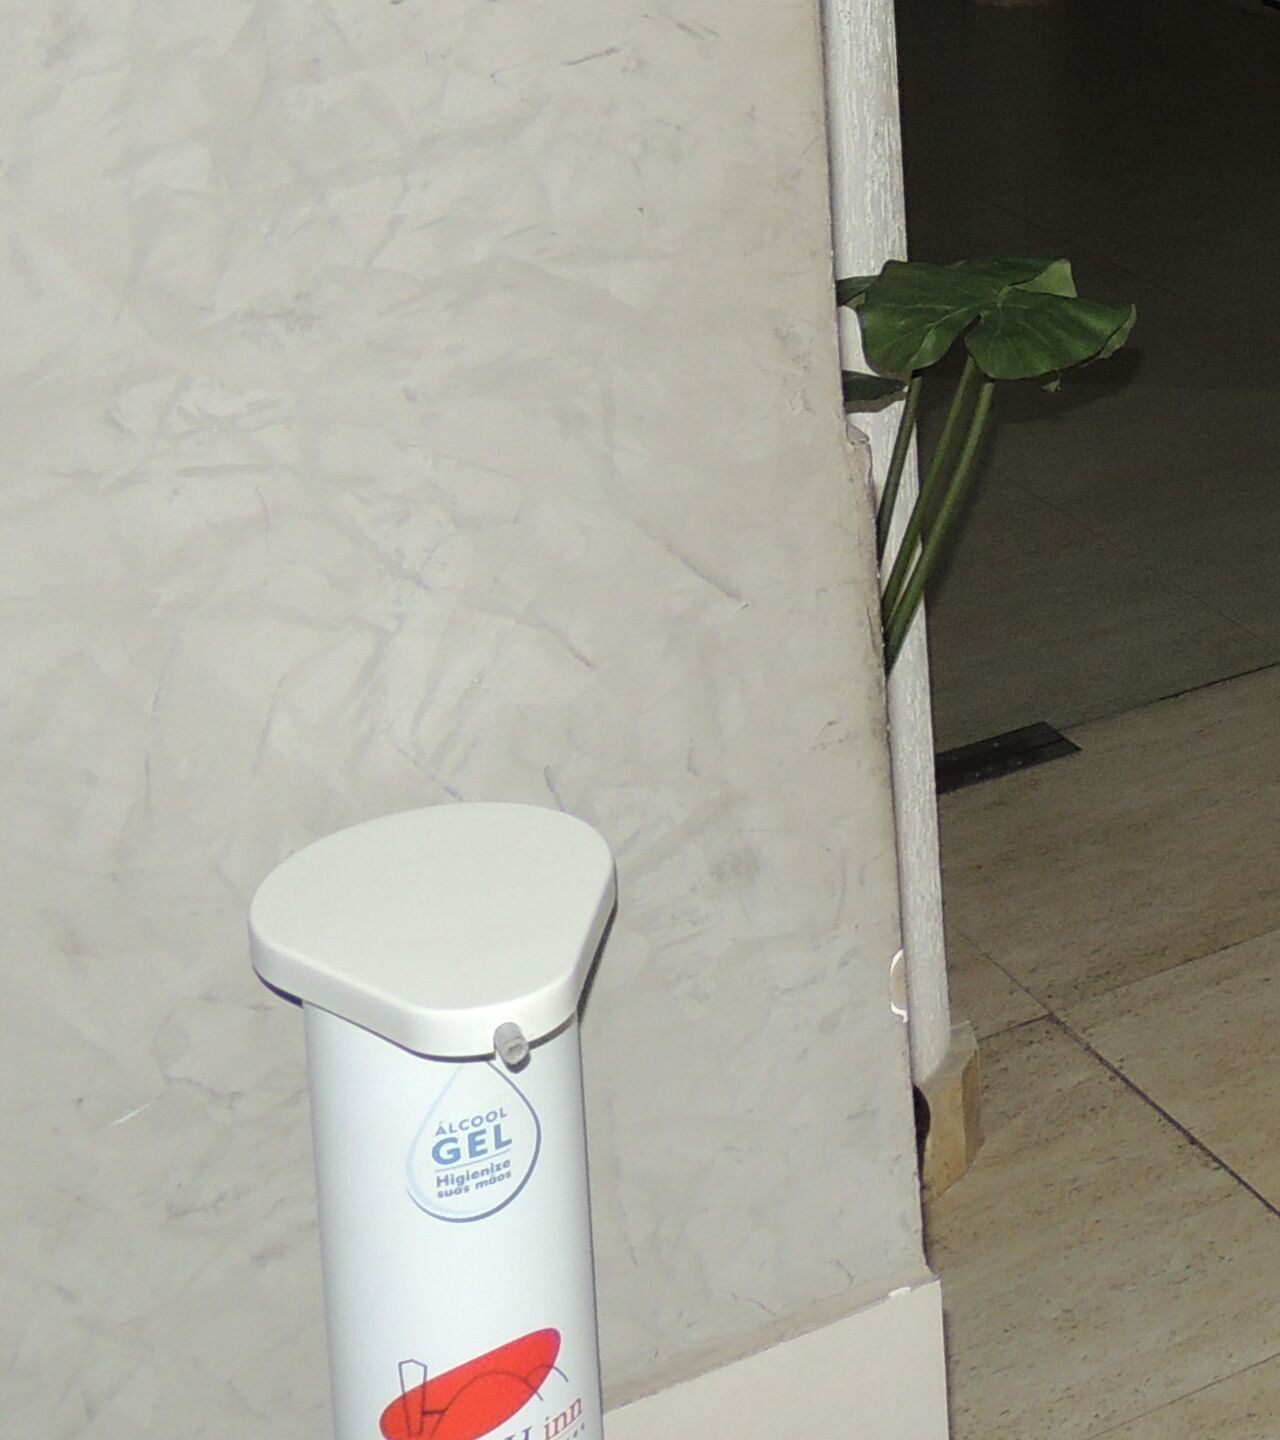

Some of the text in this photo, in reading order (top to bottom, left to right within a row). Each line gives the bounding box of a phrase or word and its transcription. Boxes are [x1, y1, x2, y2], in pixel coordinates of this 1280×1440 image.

[435, 1107, 508, 1137] ÁLCOOL
[431, 1123, 512, 1165] GEL
[436, 1160, 511, 1188] Higienize
[475, 1170, 512, 1190] mãos
[437, 1185, 470, 1199] suas
[543, 1397, 583, 1440] inn
